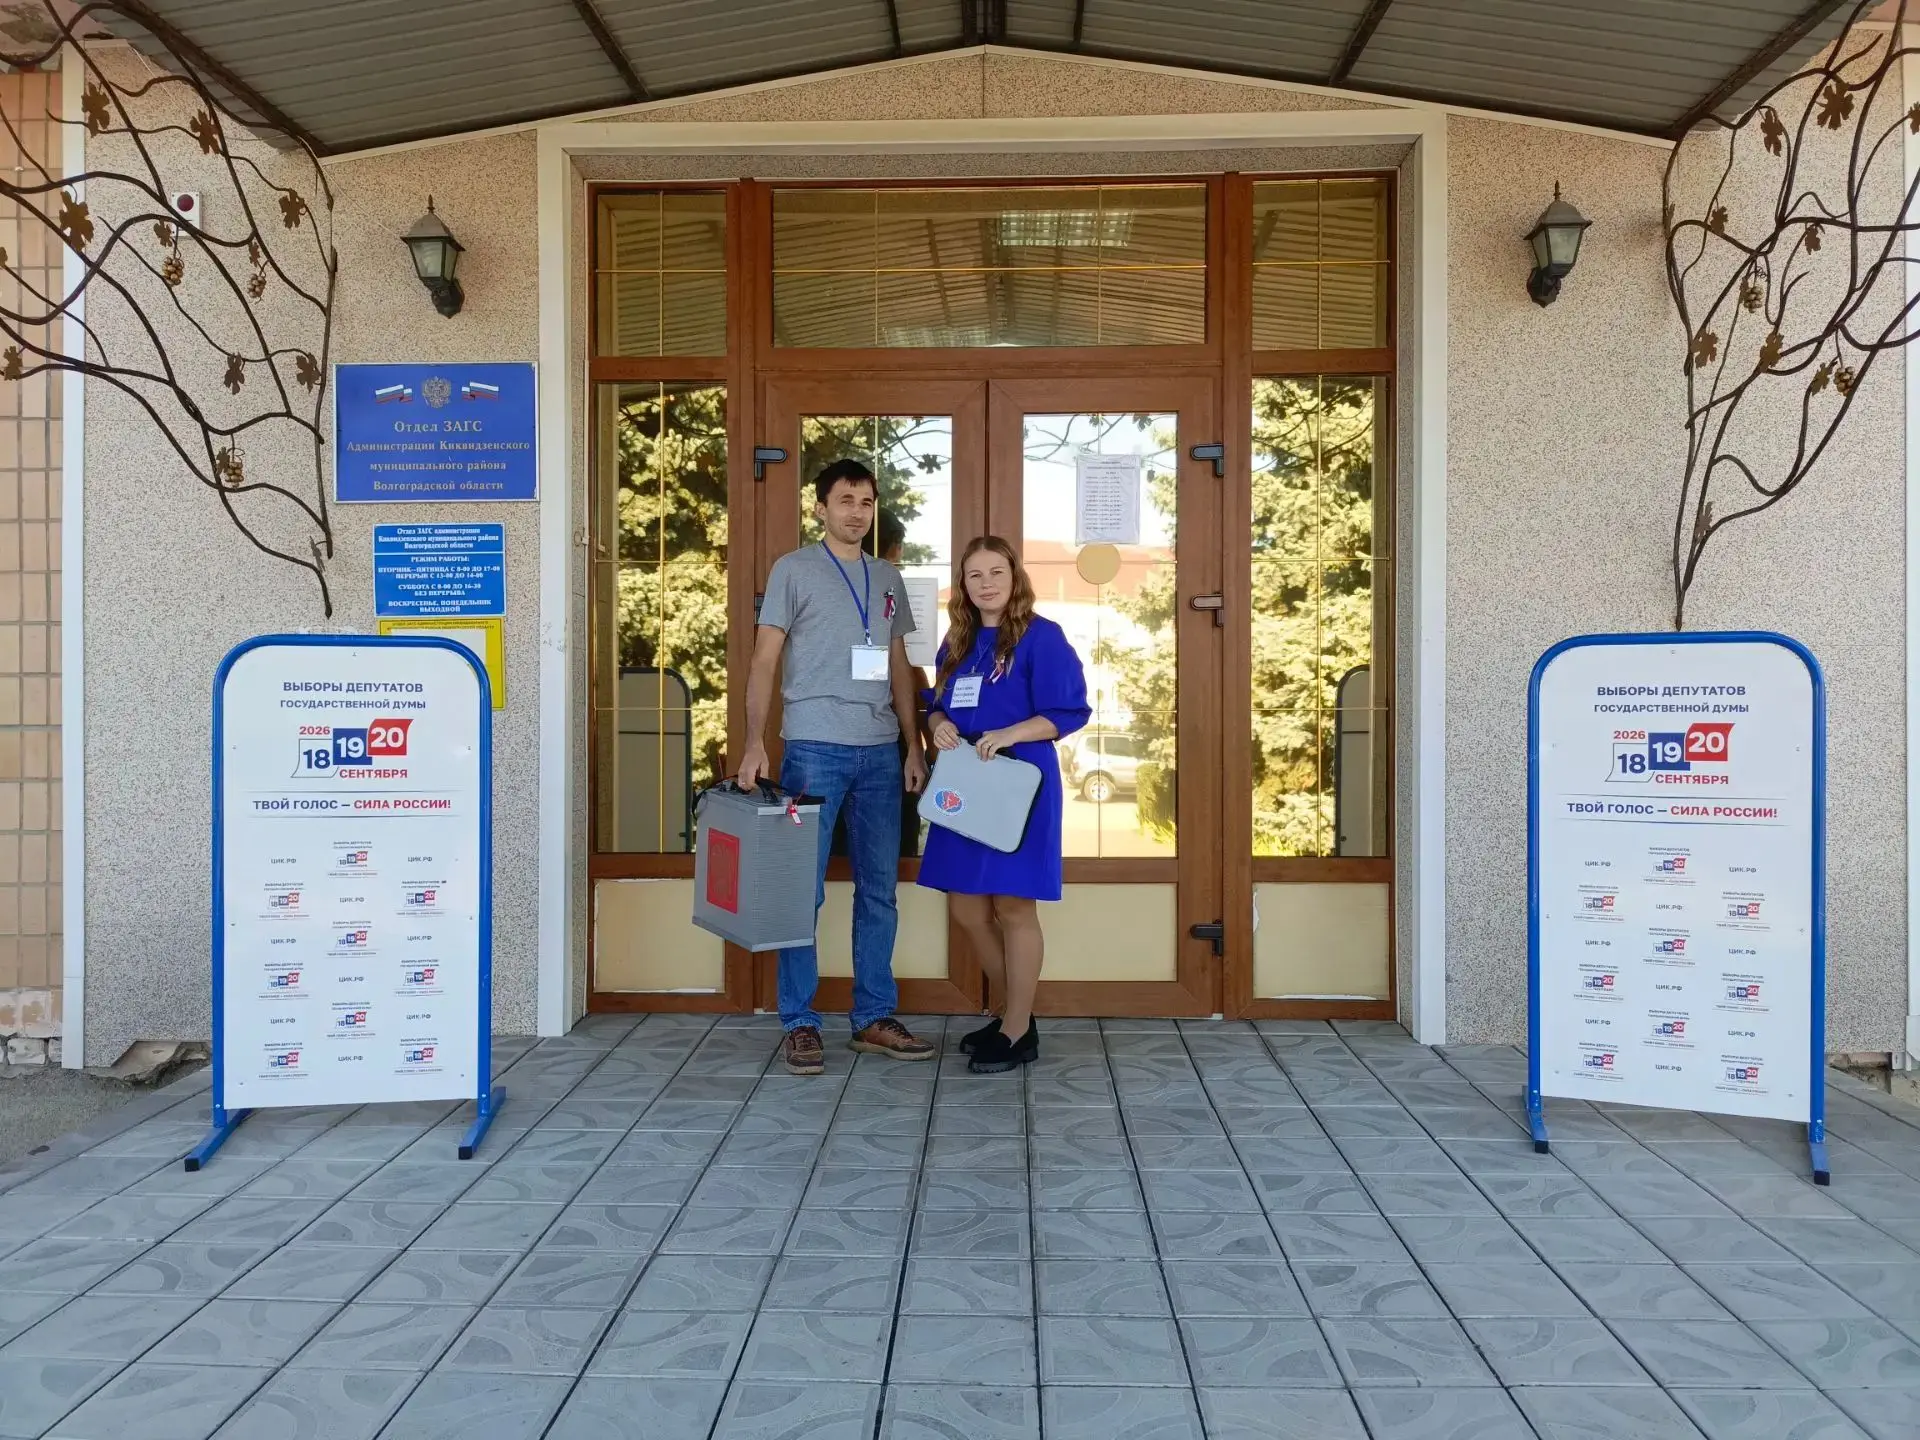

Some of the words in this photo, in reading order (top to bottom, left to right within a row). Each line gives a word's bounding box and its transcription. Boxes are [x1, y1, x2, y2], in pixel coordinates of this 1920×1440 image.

[394, 421, 438, 433] Отдел
[444, 420, 483, 432] ЗАГС
[347, 441, 435, 452] Администрации
[439, 440, 530, 451] Киквидзенского
[369, 462, 463, 472] муниципального
[467, 461, 507, 472] района
[373, 480, 456, 492] Волгоградской
[459, 480, 503, 490] области
[283, 682, 343, 692] ВЫБОРЫ
[345, 683, 423, 693] ДЕПУТАТОВ
[1597, 686, 1659, 696] ВЫБОРЫ
[1662, 686, 1746, 697] ДЕПУТАТОВ
[280, 699, 390, 709] ГОСУДАРСТВЕННОЙ
[392, 700, 426, 709] ДУМЫ
[1594, 703, 1710, 713] ГОСУДАРСТВЕННОЙ
[1712, 704, 1749, 714] ДУМЫ
[299, 726, 331, 735] 2026
[1613, 730, 1646, 740] 2026
[302, 749, 331, 769] 18
[336, 737, 365, 758] 19
[370, 727, 404, 748] 20
[1617, 753, 1646, 774] 18
[1652, 742, 1682, 763] 19
[1688, 731, 1725, 753] 20
[339, 769, 408, 779] СЕНТЯБРЯ
[1655, 774, 1729, 785] СЕНТЯБРЯ
[253, 798, 290, 810] ТВОЙ
[293, 800, 338, 810] ГОЛОС
[354, 800, 390, 809] СИЛА
[393, 799, 451, 809] РОССИИ!
[1567, 802, 1604, 814] ТВОЙ
[1607, 804, 1654, 815] ГОЛОС
[1670, 806, 1710, 816] СИЛА
[1713, 808, 1778, 818] РОССИИ!
[1674, 860, 1684, 868] 20
[288, 894, 298, 902] 20
[1603, 897, 1613, 905] 20
[357, 932, 366, 940] 20
[288, 974, 297, 982] 20
[424, 970, 433, 978] 20
[1747, 986, 1758, 994] 20
[355, 1013, 365, 1021] 20
[1673, 1023, 1684, 1031] 20
[1728, 1030, 1756, 1038] ЦИК.РФ
